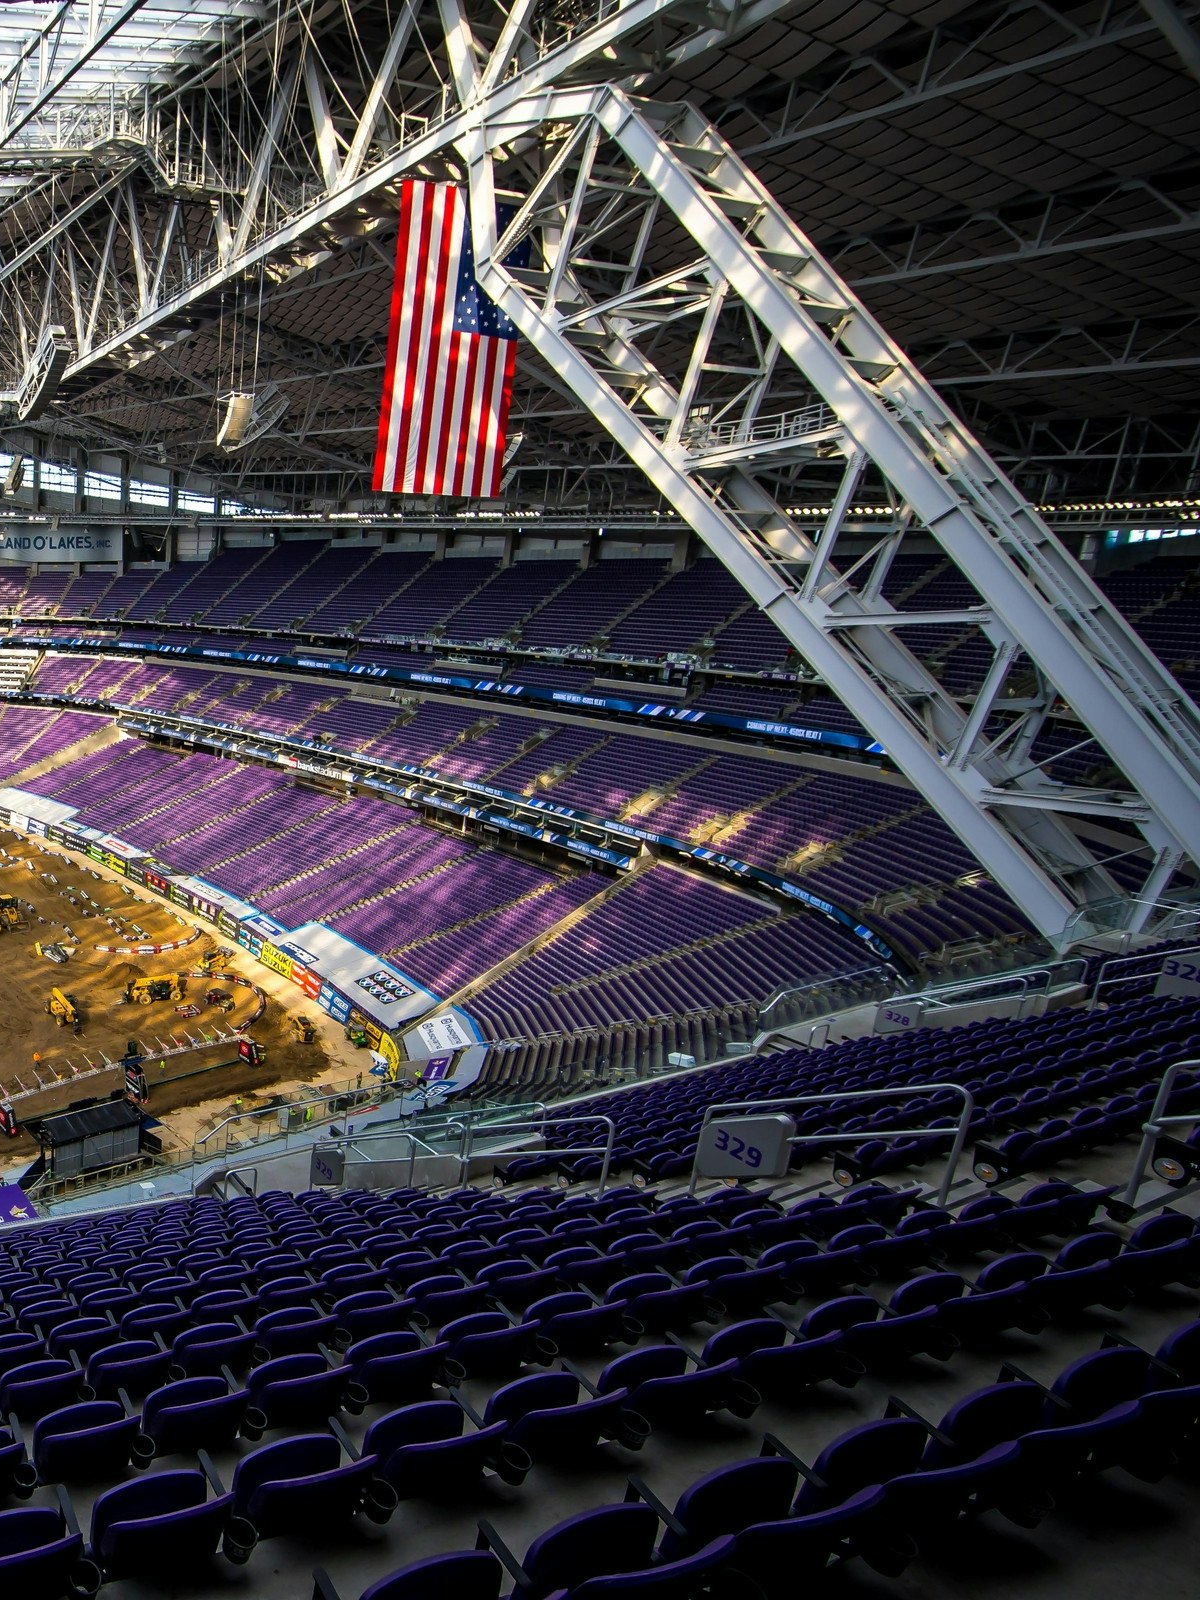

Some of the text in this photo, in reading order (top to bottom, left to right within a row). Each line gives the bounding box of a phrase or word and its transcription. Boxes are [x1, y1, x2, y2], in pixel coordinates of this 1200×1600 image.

[96, 540, 112, 548] INC.
[747, 721, 765, 730] COMING
[264, 944, 291, 967] SUZUKI
[263, 955, 290, 976] SUZUKI
[885, 1010, 909, 1026] 328
[367, 1024, 381, 1038] GOLD
[715, 1128, 762, 1168] 329
[315, 1157, 332, 1180] 329
